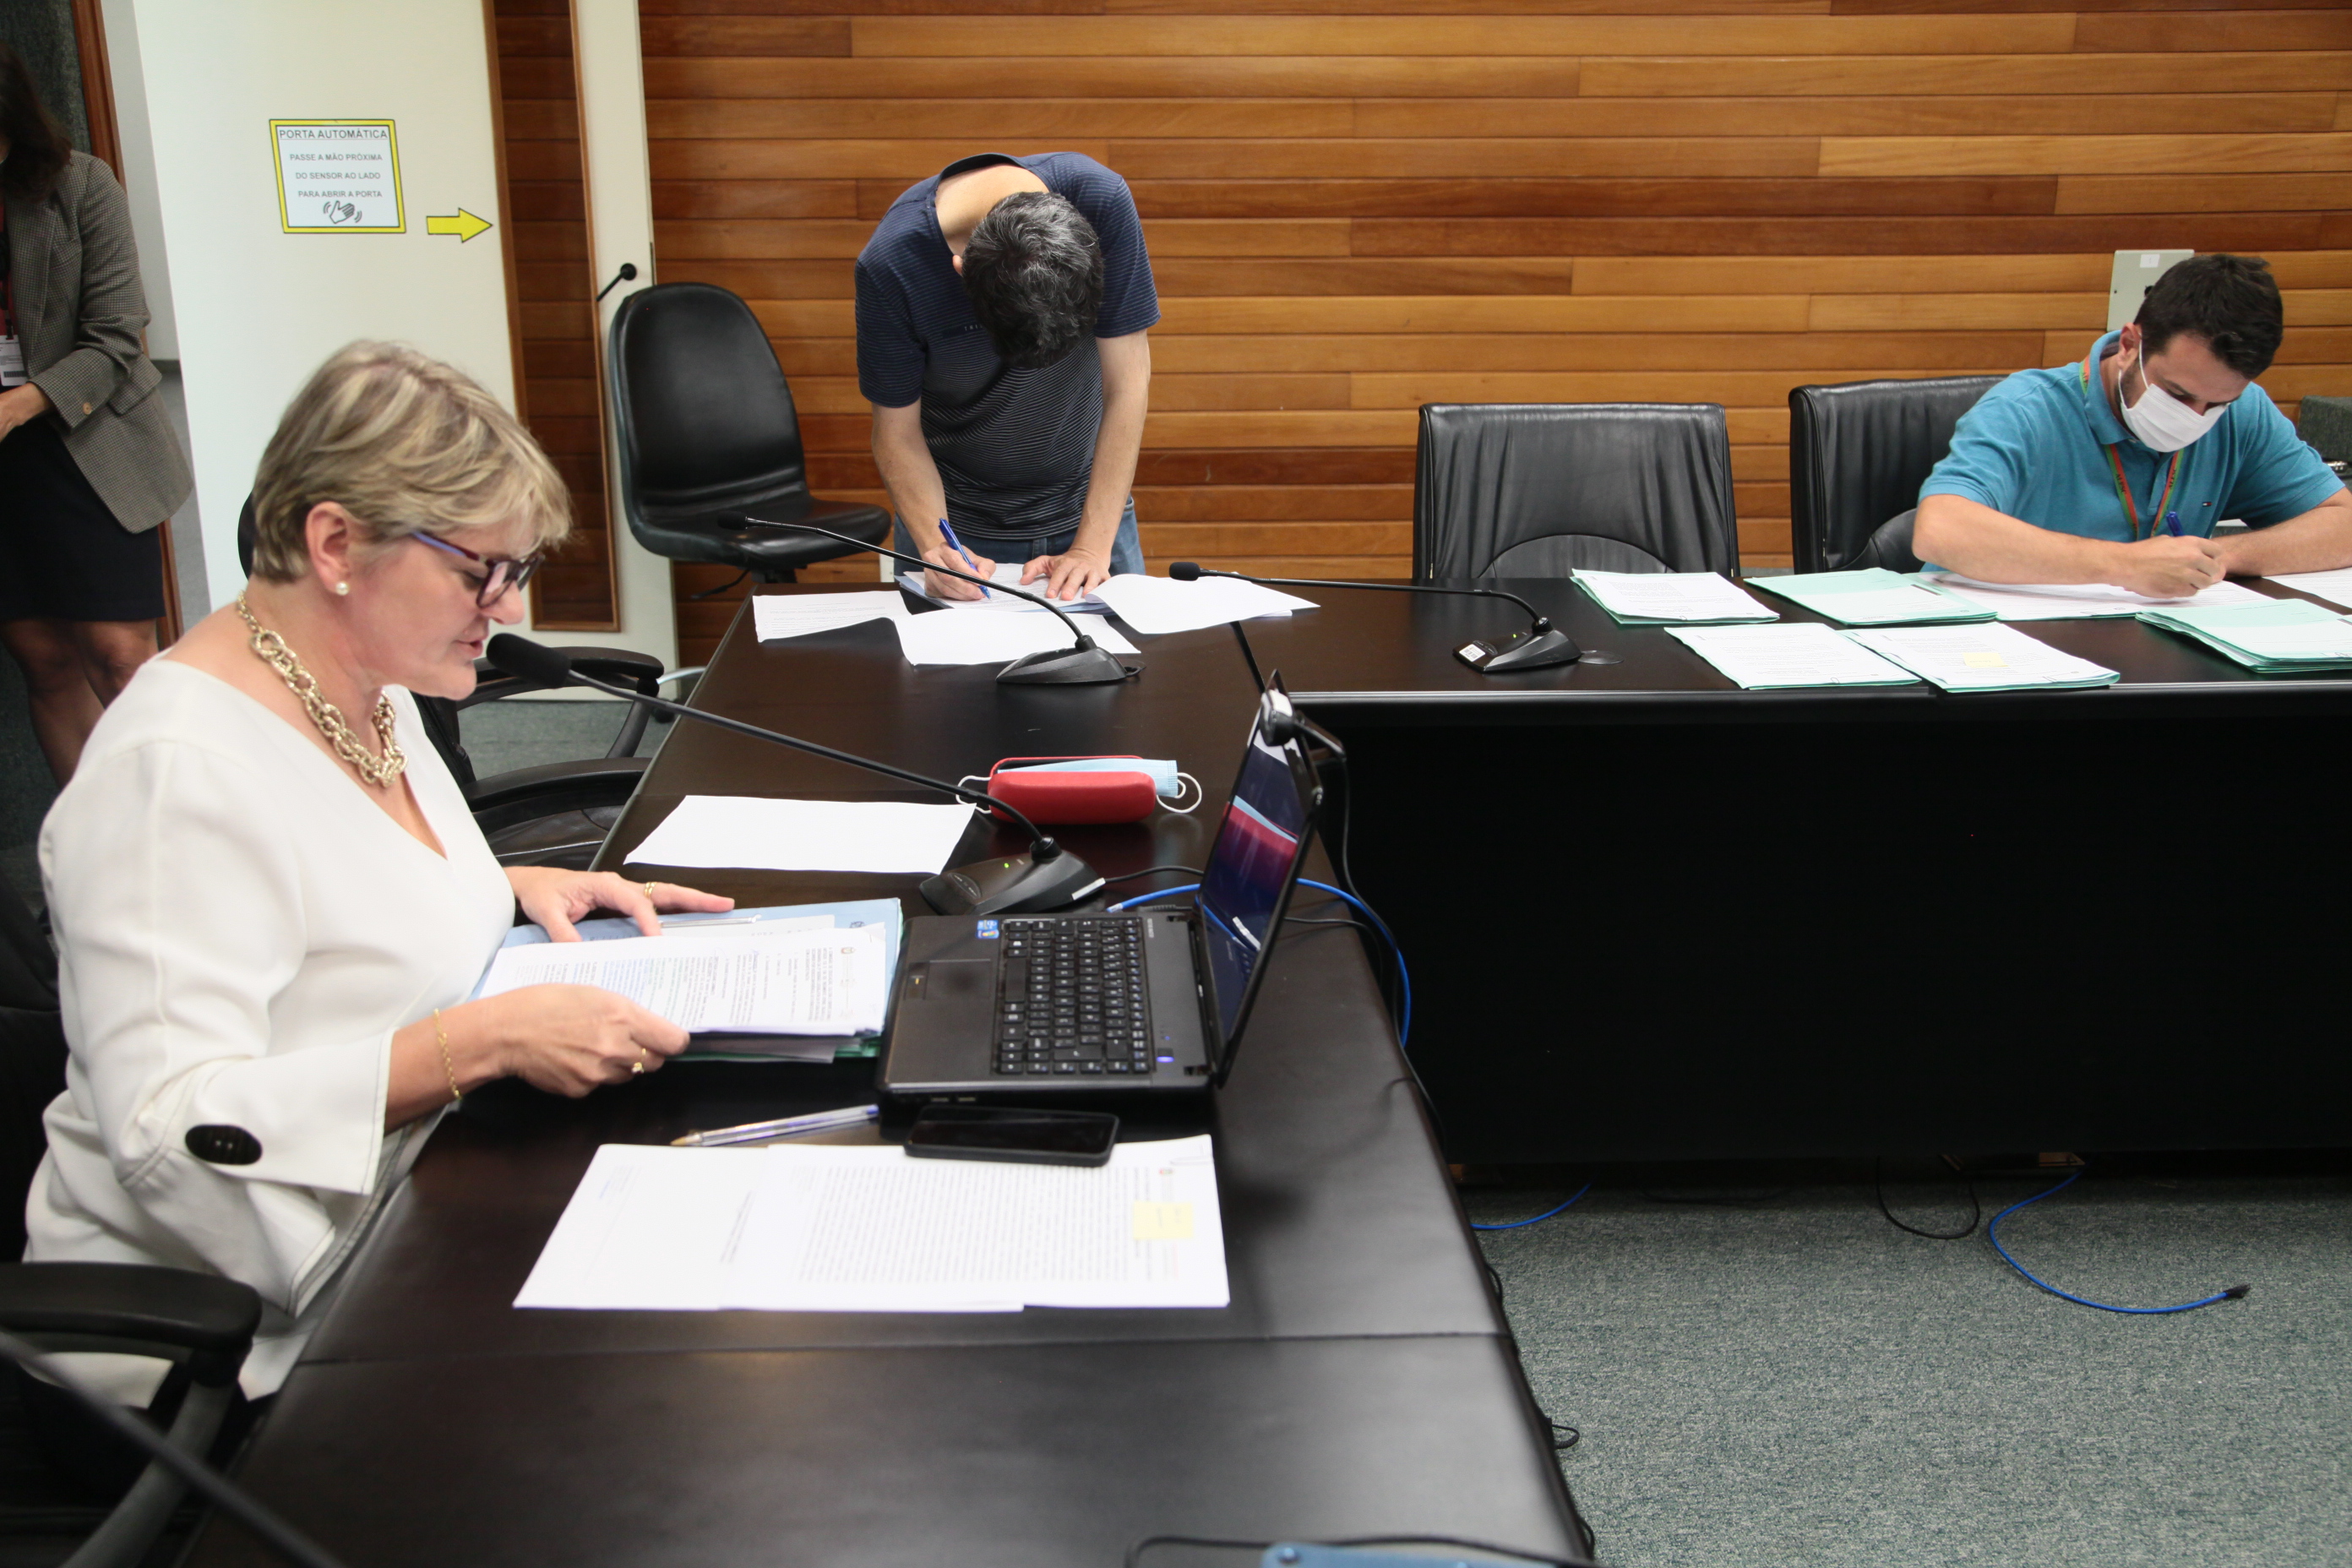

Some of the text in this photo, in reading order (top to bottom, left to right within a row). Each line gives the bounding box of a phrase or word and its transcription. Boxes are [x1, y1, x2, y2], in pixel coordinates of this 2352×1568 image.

[280, 128, 388, 139] PORTA AUTOMÁTICA
[325, 152, 344, 161] MÃO
[346, 152, 383, 161] PRÓXIMA
